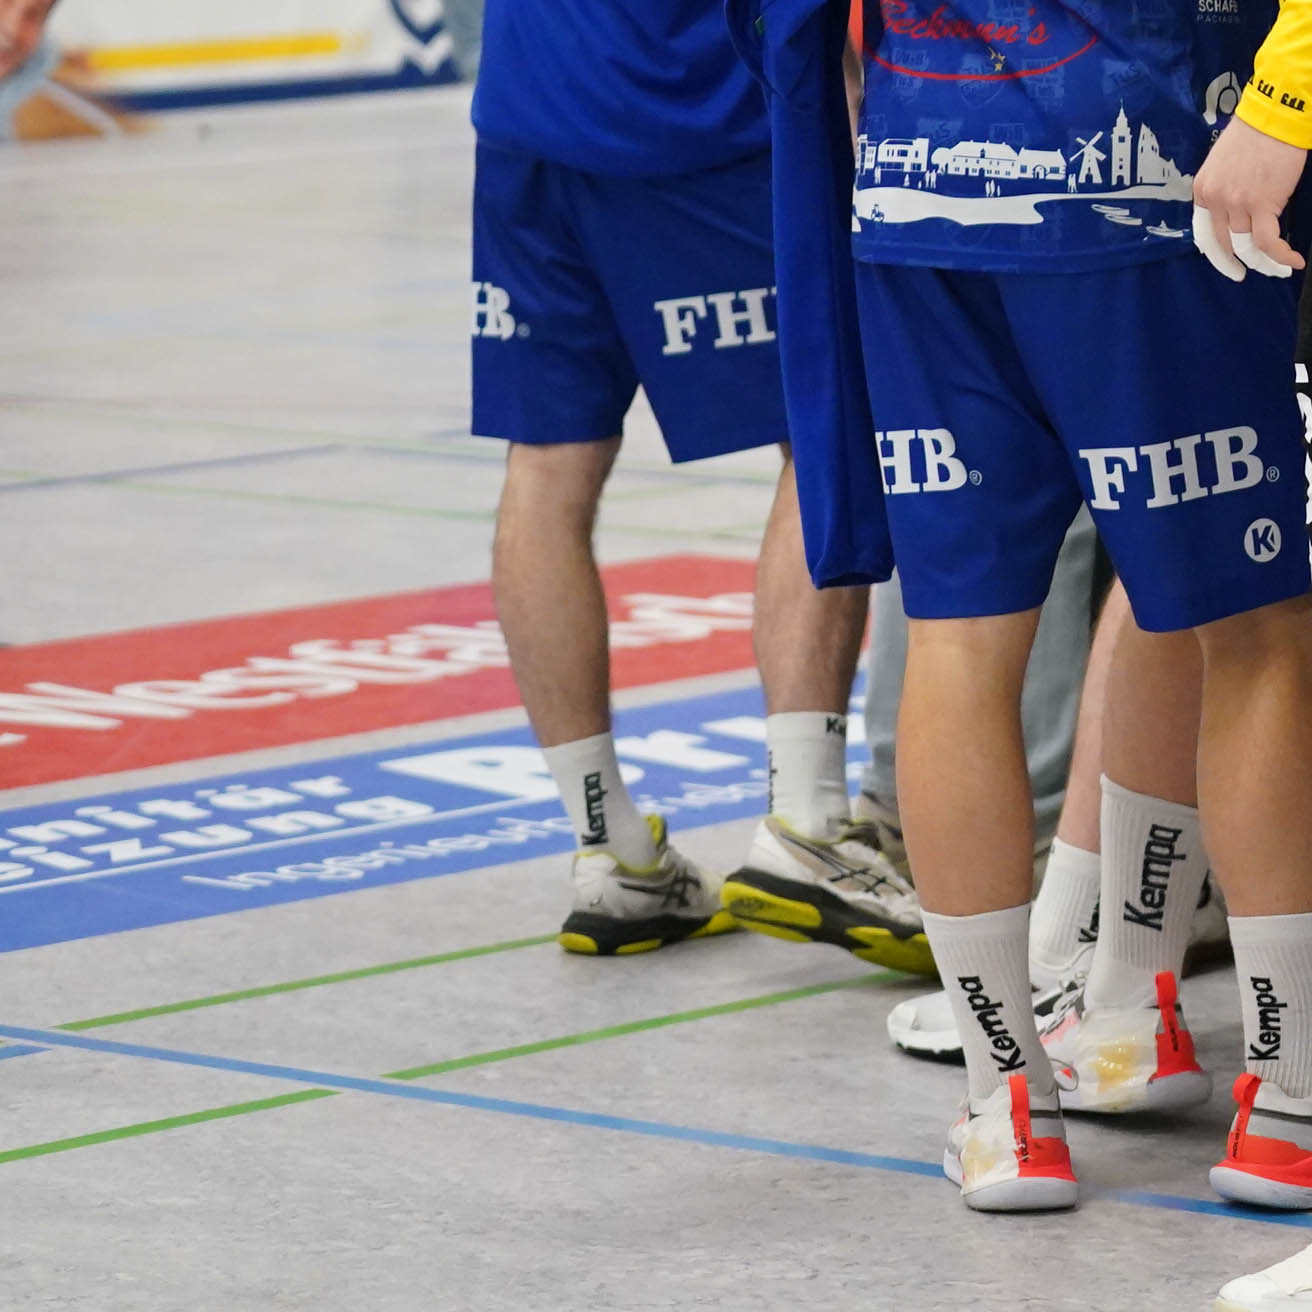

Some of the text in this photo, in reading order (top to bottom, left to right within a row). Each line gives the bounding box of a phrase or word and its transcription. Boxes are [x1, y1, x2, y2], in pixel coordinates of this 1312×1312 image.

[1078, 425, 1264, 511] FHB
[581, 771, 609, 846] Kempa
[1123, 823, 1187, 931] Kempa
[957, 975, 1028, 1073] Kempa
[1247, 976, 1287, 1062] Kempa
